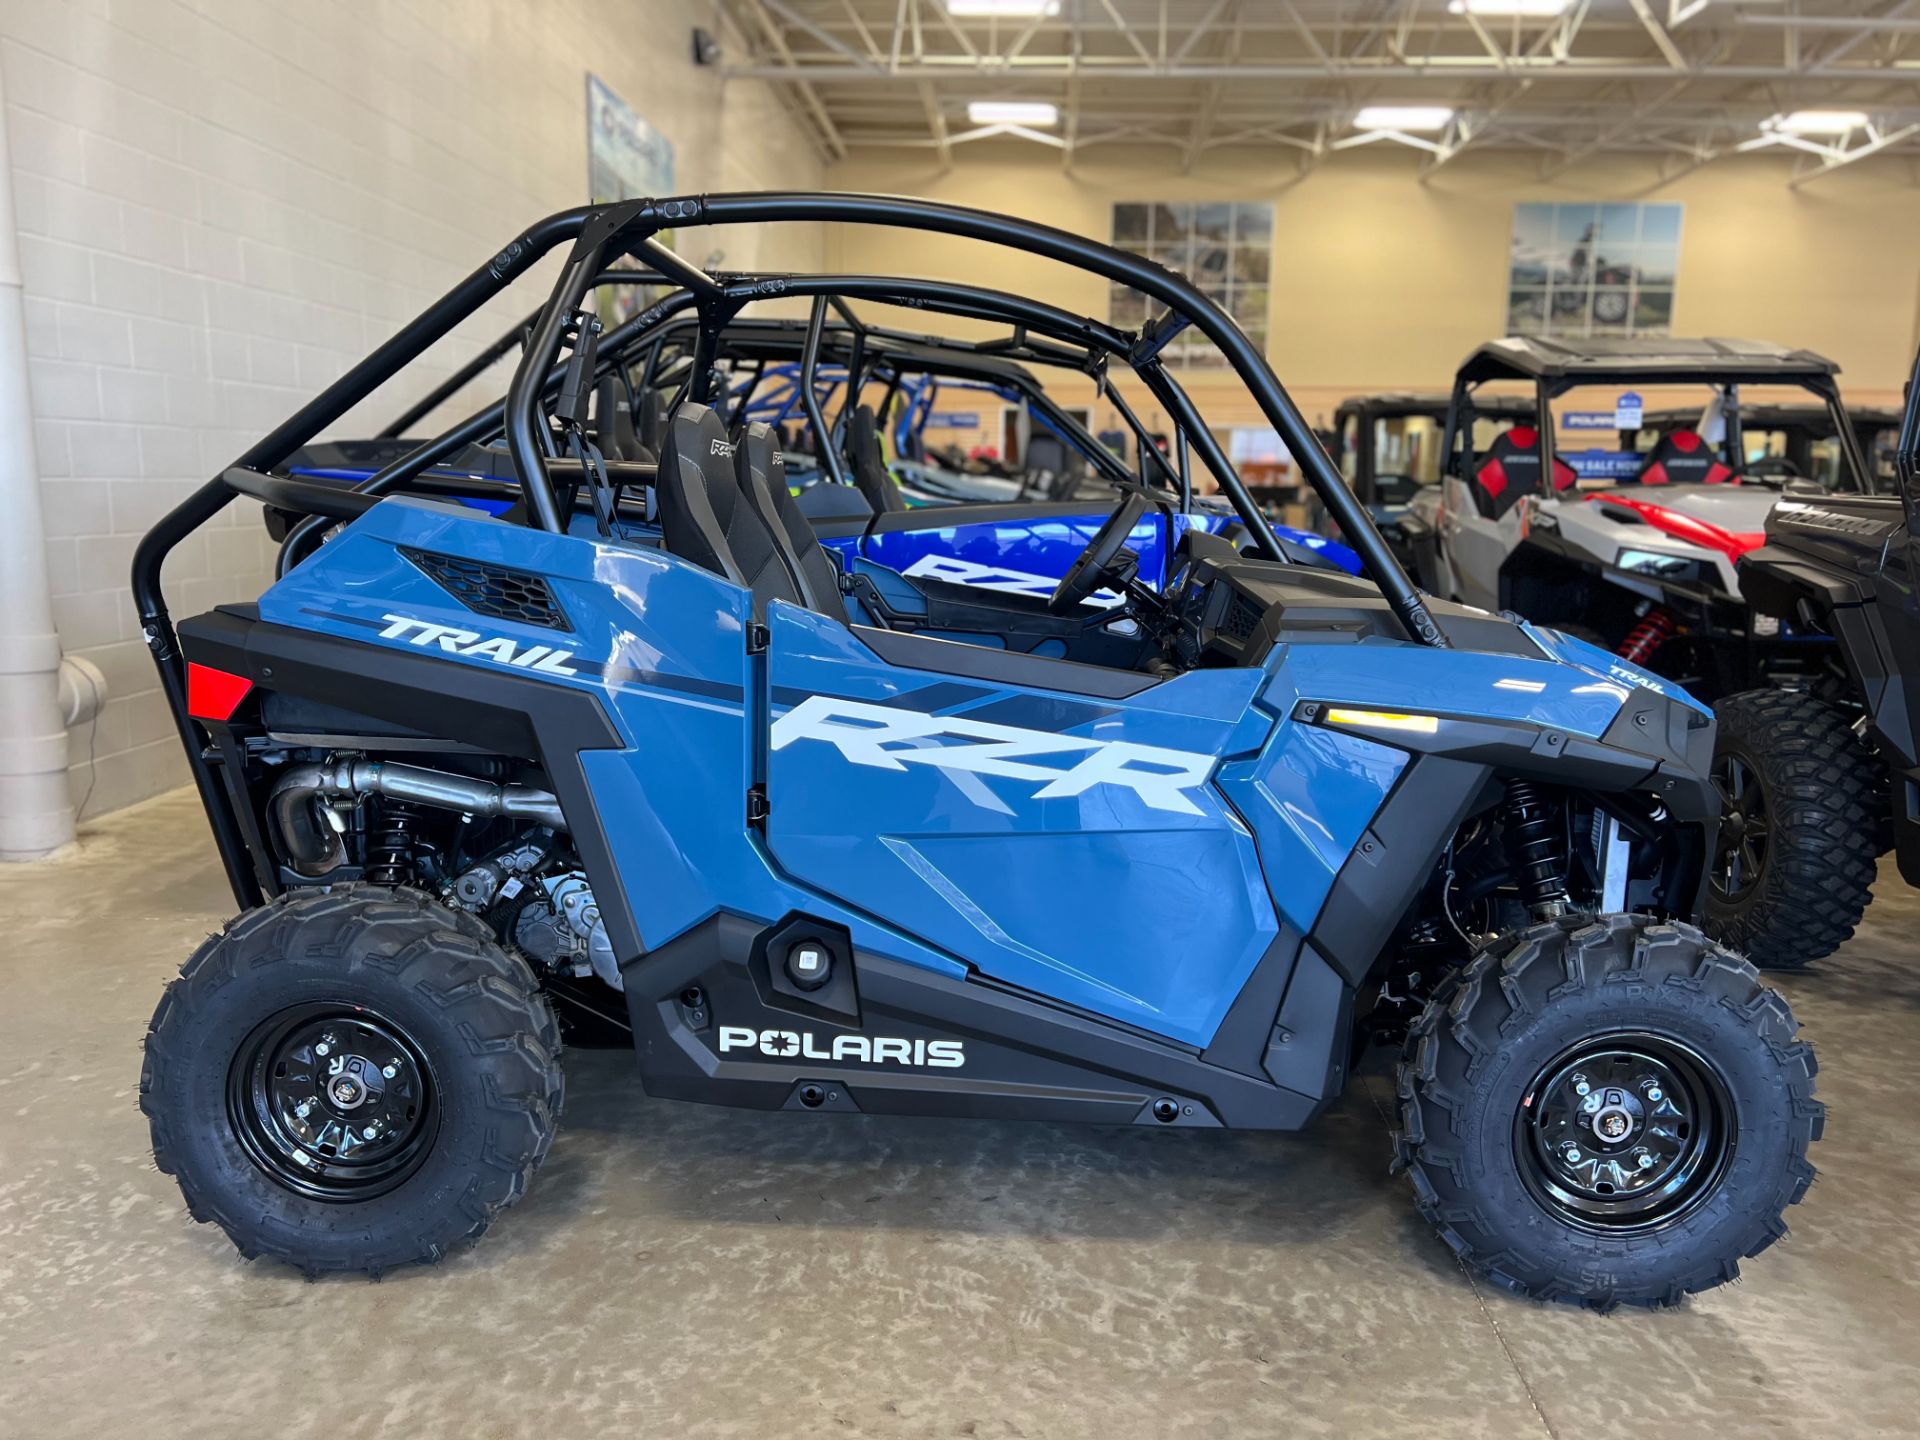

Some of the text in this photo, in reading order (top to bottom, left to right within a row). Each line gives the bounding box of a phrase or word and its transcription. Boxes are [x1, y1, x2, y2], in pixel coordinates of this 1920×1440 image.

[1587, 460, 1614, 471] SALE
[378, 613, 577, 676] TRAIL
[1610, 665, 1665, 695] TRAIL
[771, 695, 1217, 817] RZR
[719, 1026, 966, 1068] POLARIS
